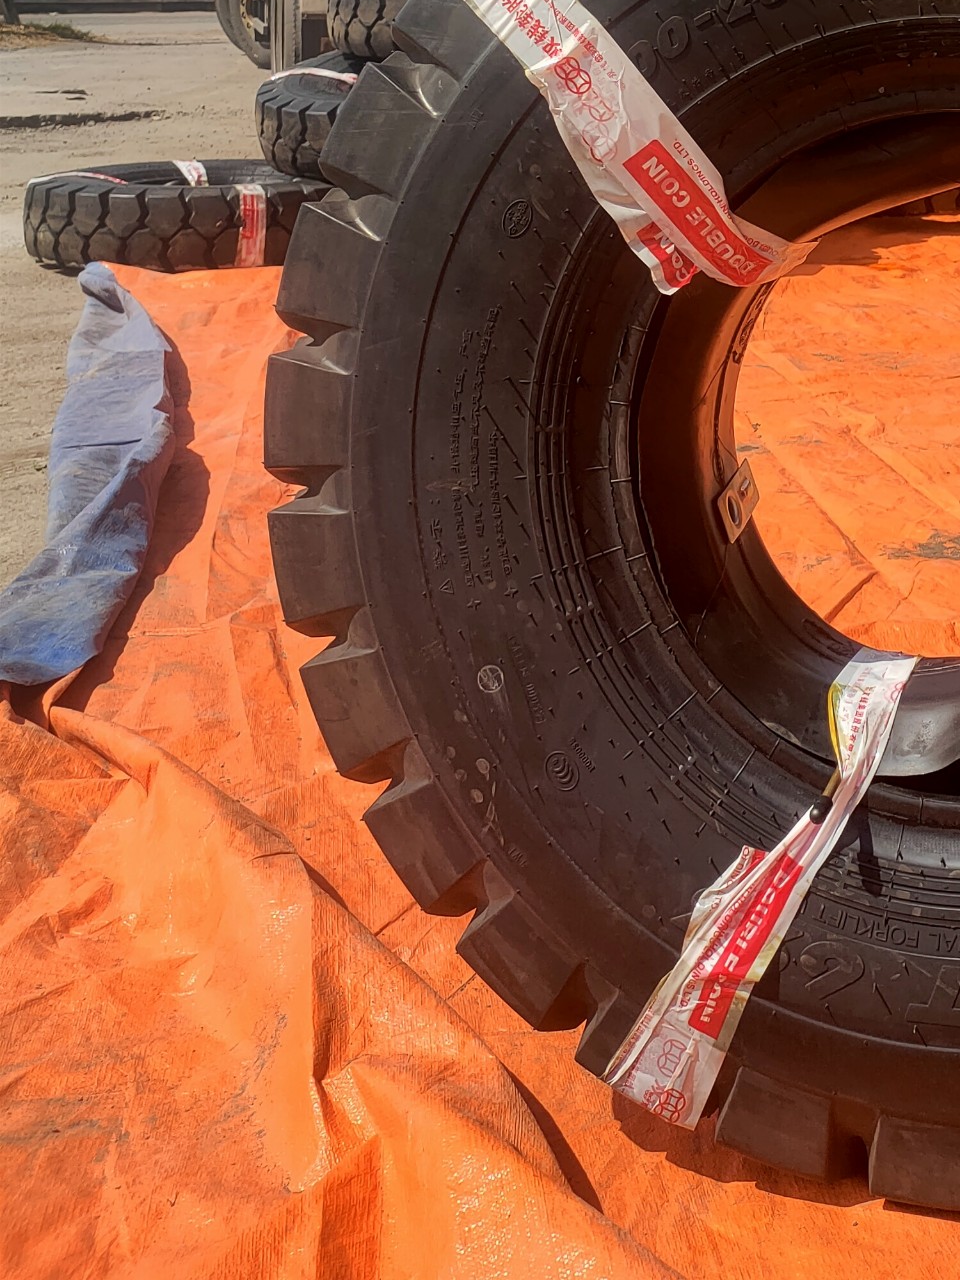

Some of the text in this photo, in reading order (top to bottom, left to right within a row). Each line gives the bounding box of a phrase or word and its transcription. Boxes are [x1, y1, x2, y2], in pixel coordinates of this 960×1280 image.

[673, 138, 690, 159] LTD.
[687, 158, 724, 205] HOLDINGS
[641, 155, 757, 275] DOUBLE COIN
[820, 903, 920, 949] FORKLIFT
